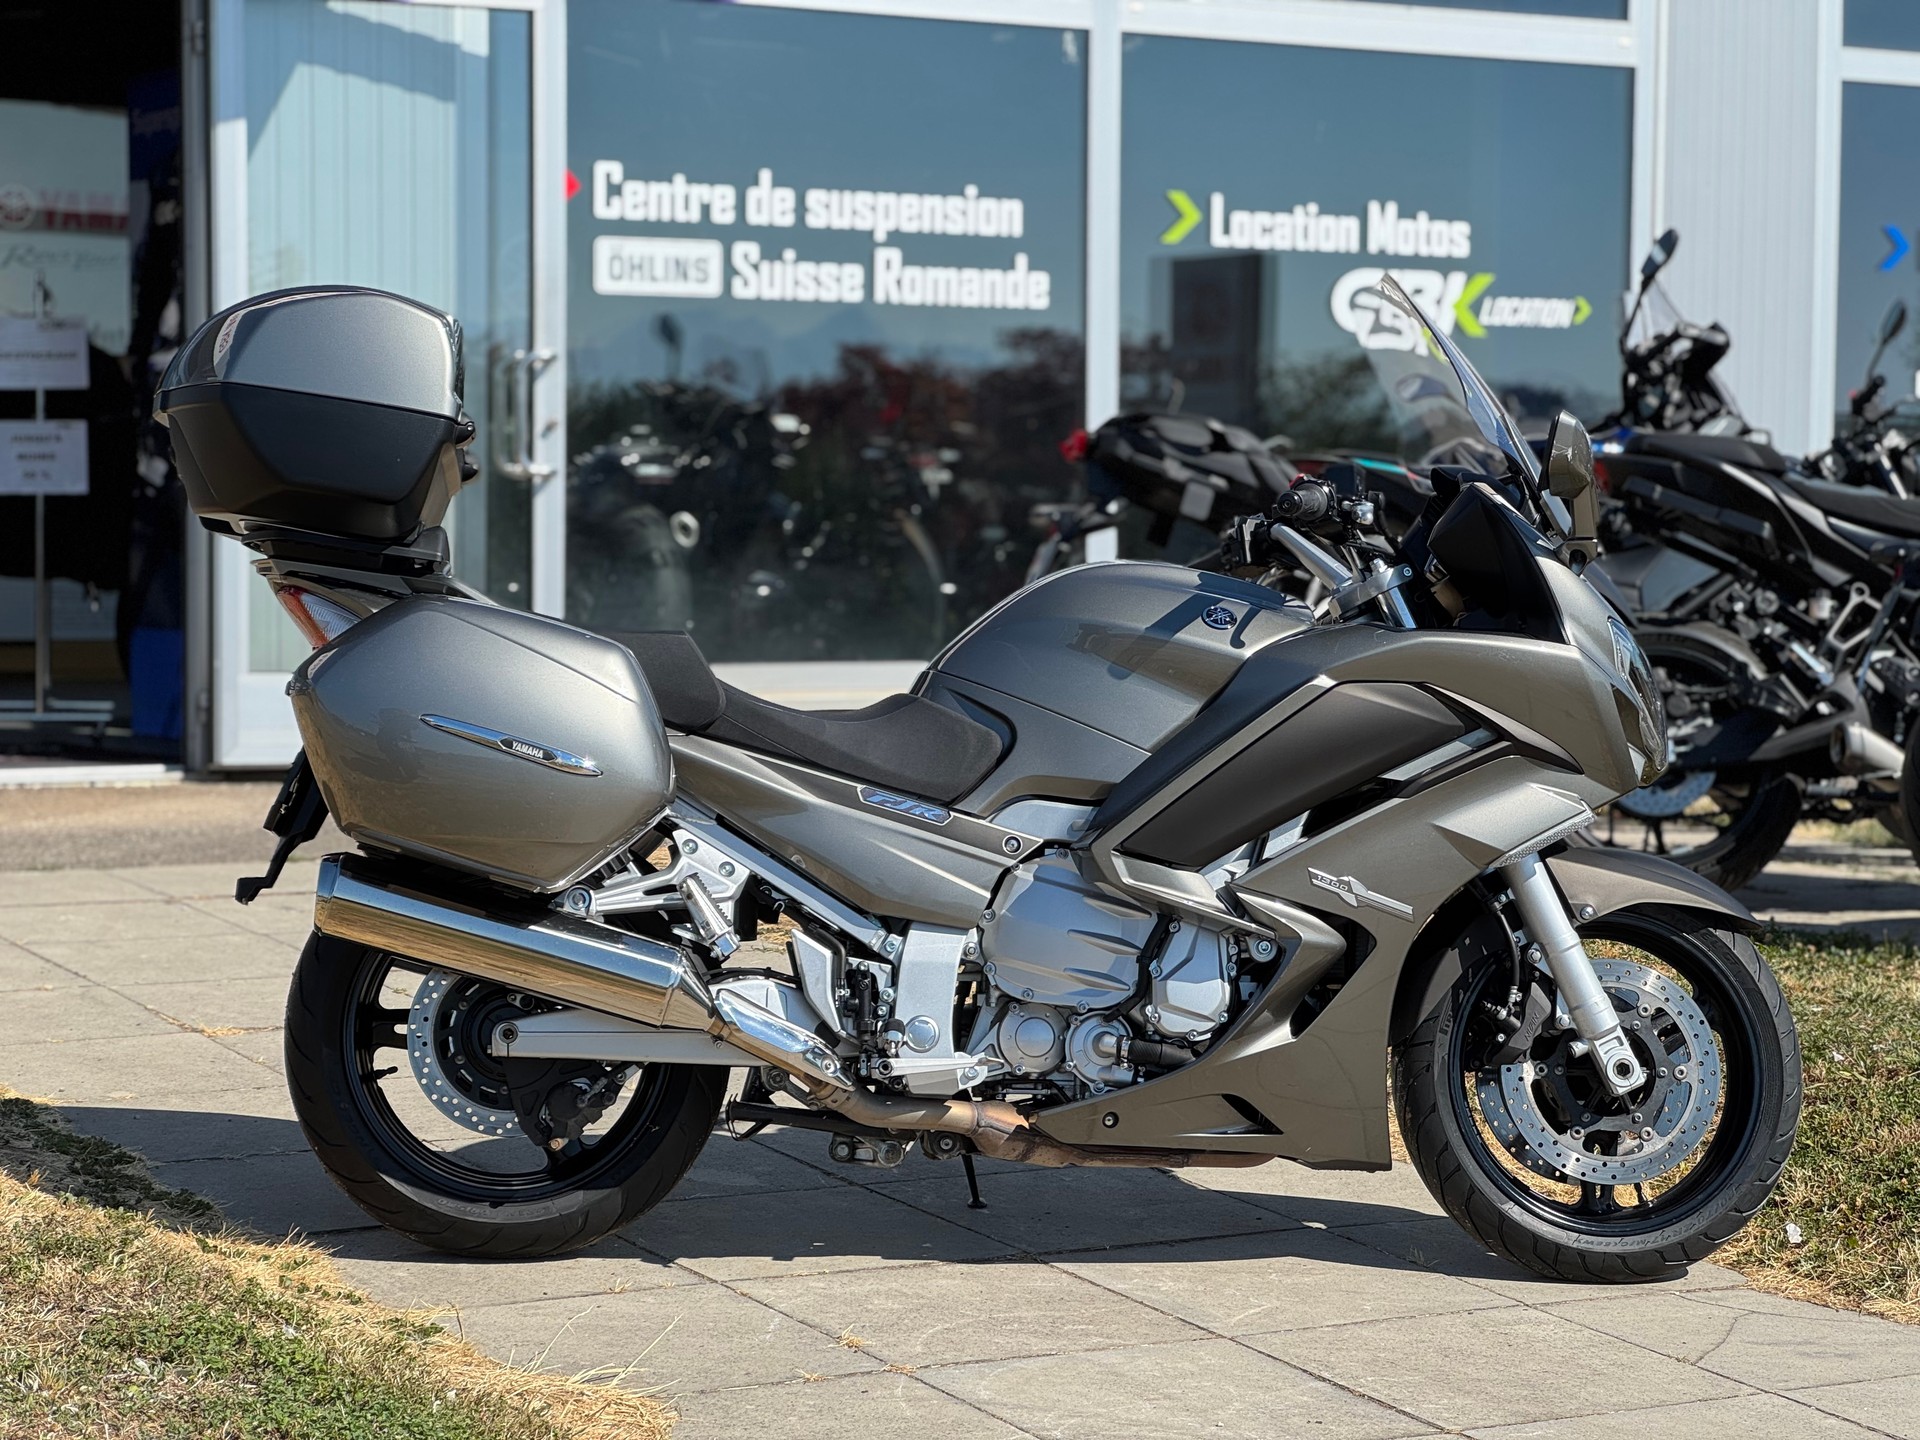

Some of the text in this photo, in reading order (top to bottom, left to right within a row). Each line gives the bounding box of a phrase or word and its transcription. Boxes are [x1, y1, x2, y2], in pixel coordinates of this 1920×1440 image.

[592, 159, 1024, 243] Centre de suspension
[1210, 191, 1471, 258] Location Motos
[608, 240, 1051, 310] ÖHLINS Suisse Romande
[1478, 296, 1577, 329] LOCATION
[512, 740, 544, 759] YAMAHA
[1316, 875, 1348, 892] 1300
